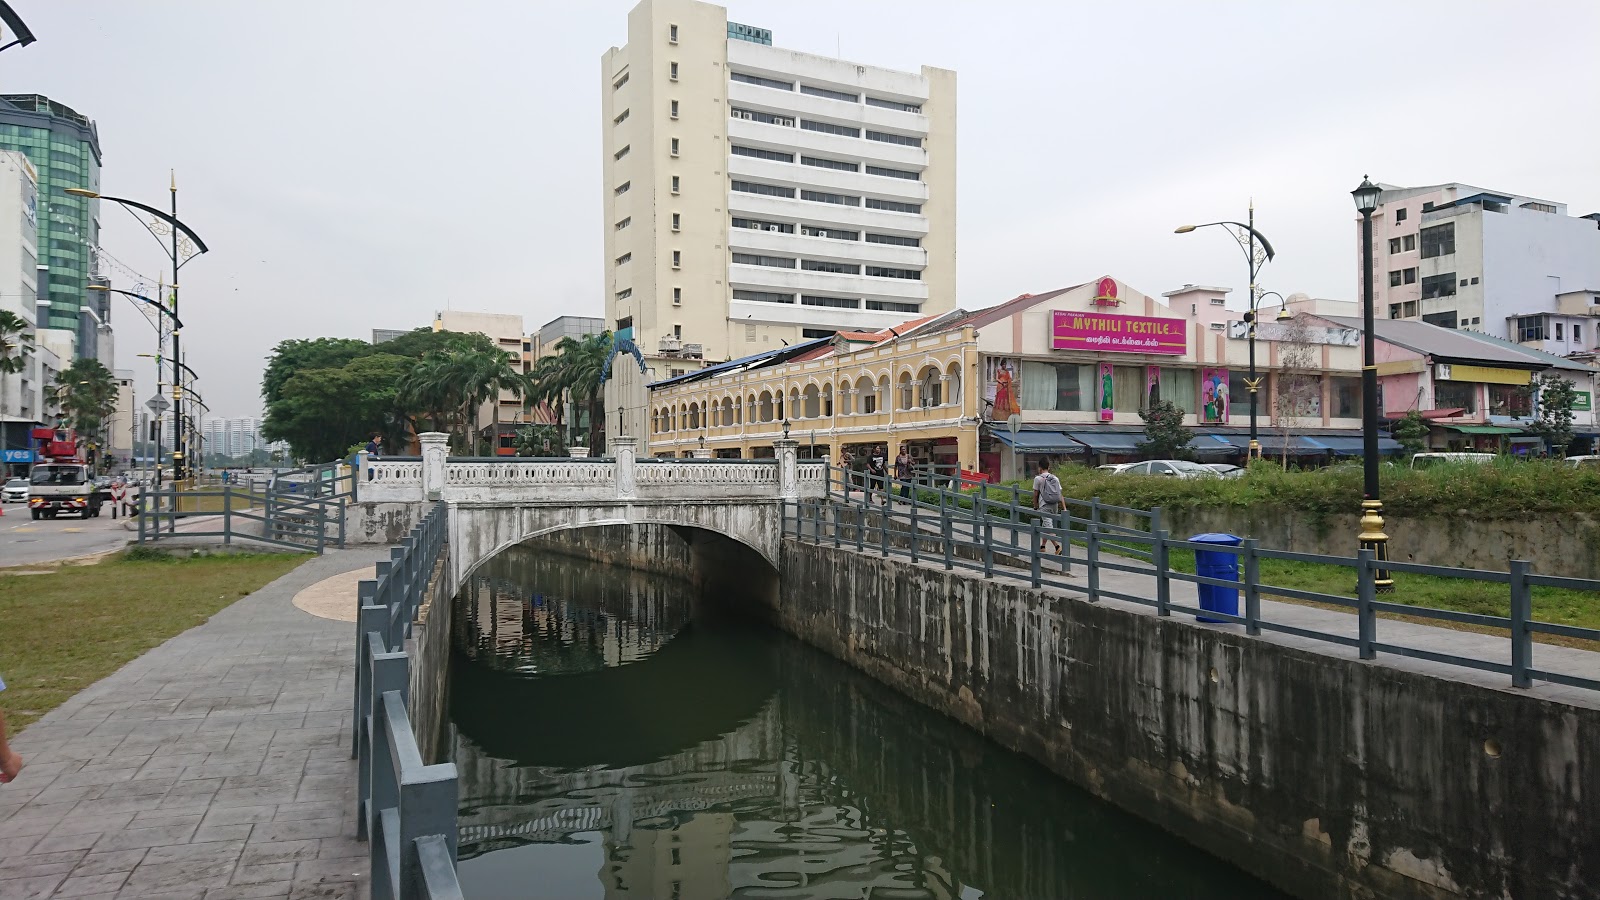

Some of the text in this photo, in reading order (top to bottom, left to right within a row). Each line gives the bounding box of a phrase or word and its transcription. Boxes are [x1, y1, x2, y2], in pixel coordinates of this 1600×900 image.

[1073, 317, 1169, 335] MYTHILI TEXTILE
[5, 450, 29, 462] yes
